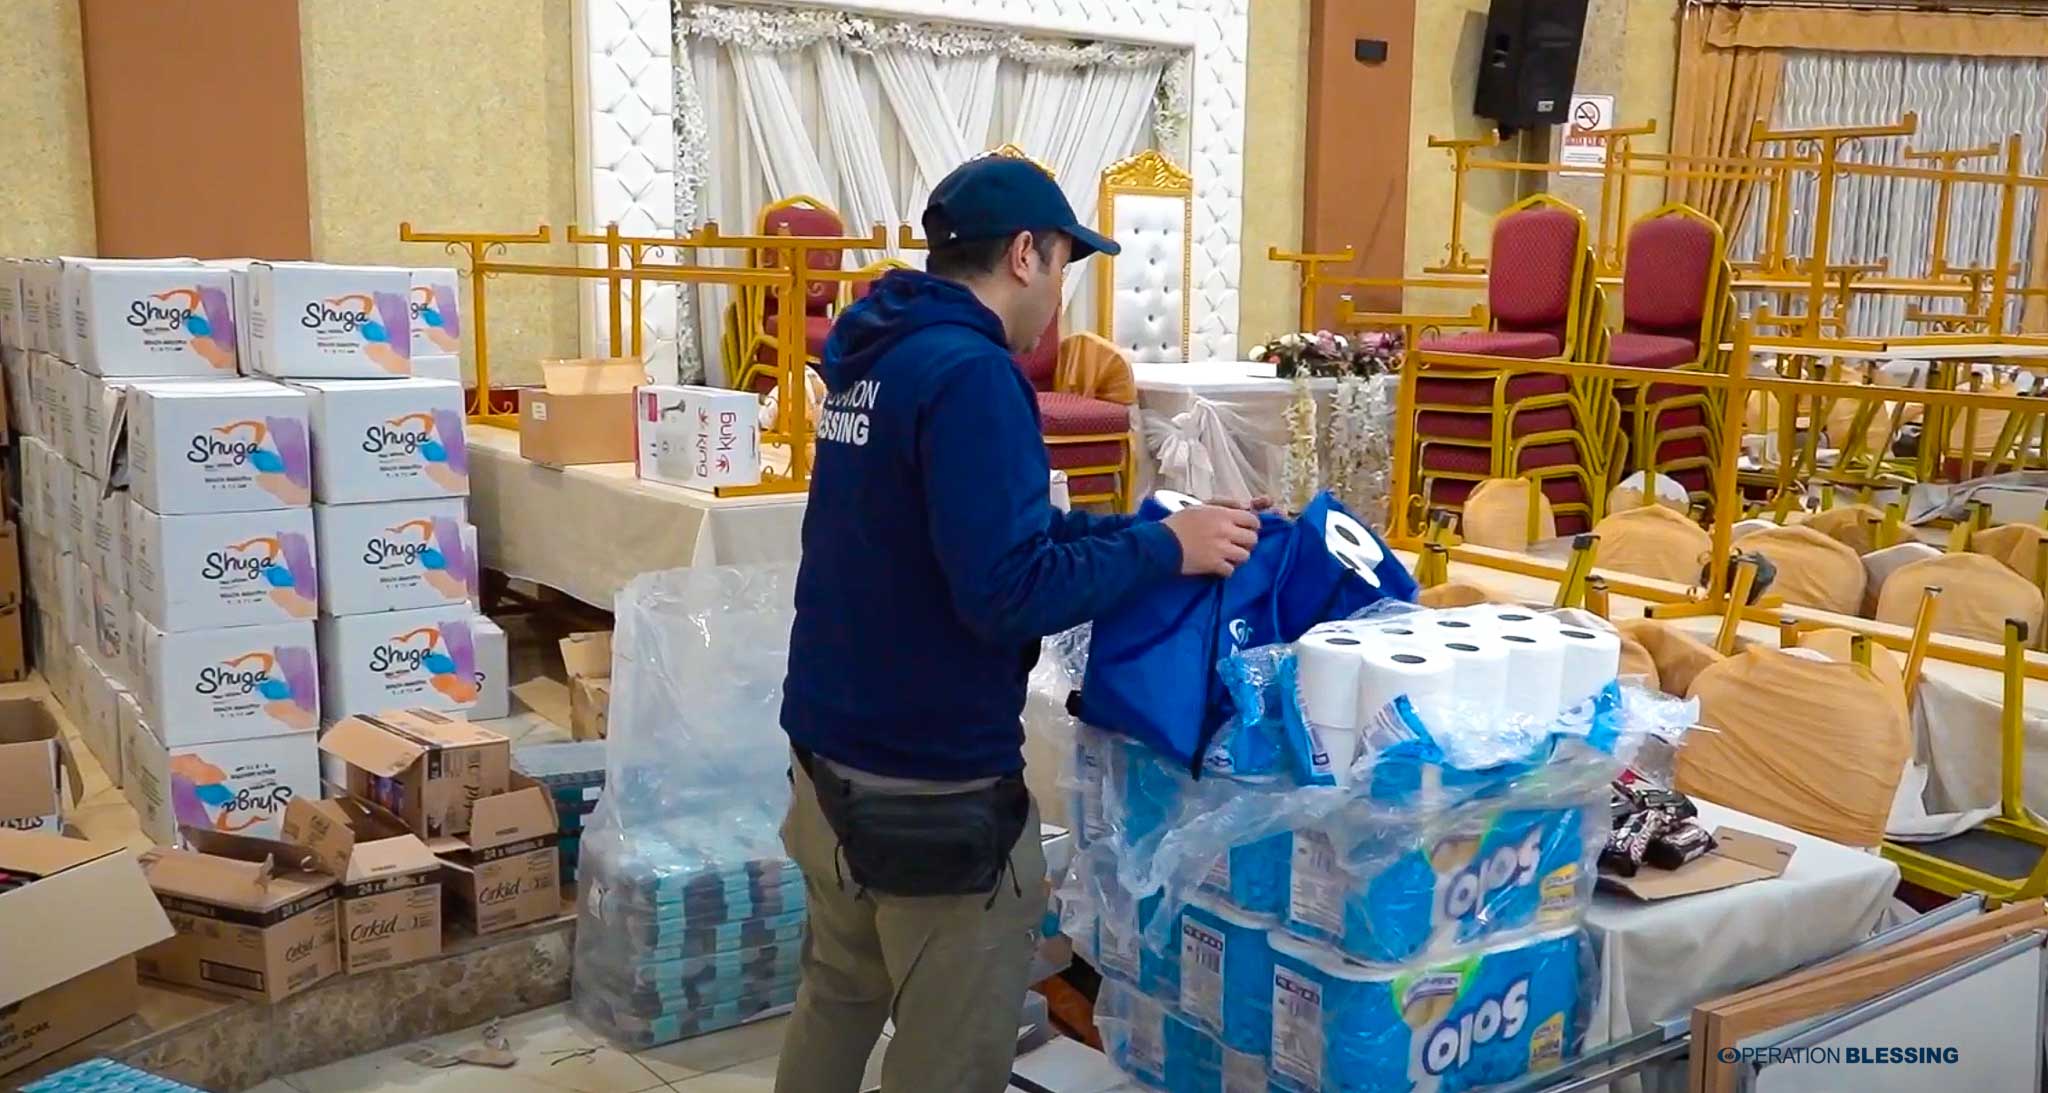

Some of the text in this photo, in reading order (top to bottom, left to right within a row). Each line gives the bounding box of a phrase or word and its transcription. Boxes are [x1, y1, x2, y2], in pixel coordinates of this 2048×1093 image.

[127, 301, 192, 330] Shuga
[301, 303, 368, 332] Shuga
[362, 426, 431, 454] Shuga
[716, 411, 737, 451] king
[187, 435, 261, 465] Shuga
[695, 433, 709, 478] king
[202, 552, 276, 580] Shuga
[363, 538, 432, 565] Shuga
[369, 645, 433, 672] Shuga
[196, 667, 269, 693] Shuga
[1424, 976, 1531, 1074] Solo
